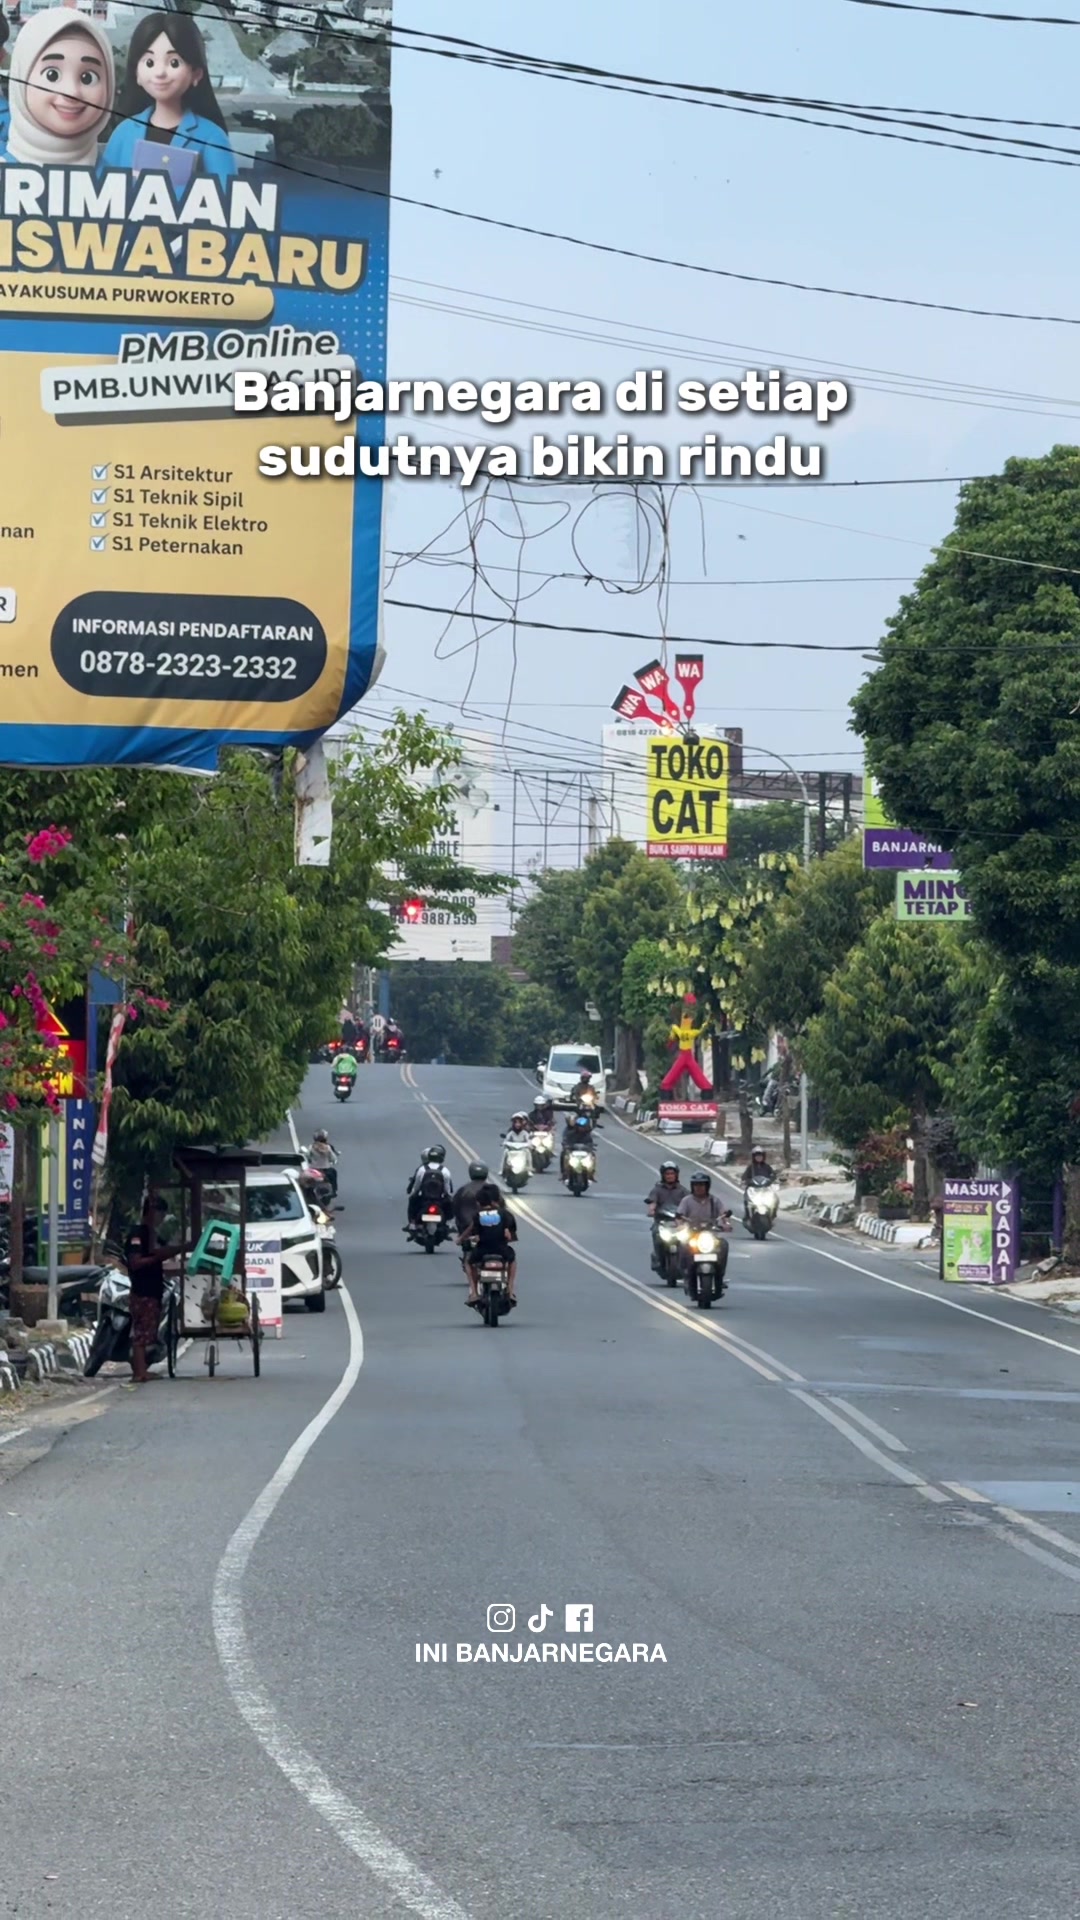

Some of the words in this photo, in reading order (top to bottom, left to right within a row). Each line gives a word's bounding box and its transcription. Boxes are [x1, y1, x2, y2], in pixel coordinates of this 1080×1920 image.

[4, 168, 277, 231] RIMAAN
[186, 228, 364, 290] BARU
[112, 288, 235, 306] PURWOKERTO
[121, 334, 205, 364] PMB
[217, 328, 336, 360] Online
[114, 464, 135, 479] S1
[140, 465, 233, 483] Arsitektur
[113, 488, 135, 503] S1
[139, 489, 198, 506] Teknik
[203, 491, 243, 510] Sipil
[1, 526, 35, 539] nan
[112, 512, 134, 527] S1
[139, 512, 198, 530] Teknik
[203, 514, 268, 533] Elektro
[112, 536, 134, 551] S1
[139, 537, 244, 555] Peternakan
[72, 618, 175, 636] INFORMASI
[179, 621, 313, 641] PENDAFTARAN
[80, 649, 297, 680] 0878-2323-2332
[677, 663, 701, 678] WA
[640, 670, 666, 691] WA
[619, 693, 642, 716] WA
[651, 744, 724, 780] TOKO
[652, 788, 721, 834] CAT
[421, 911, 452, 925] 9887
[903, 901, 959, 916] TETAP
[944, 1183, 1000, 1196] MASUK
[995, 1199, 1012, 1281] GADAI
